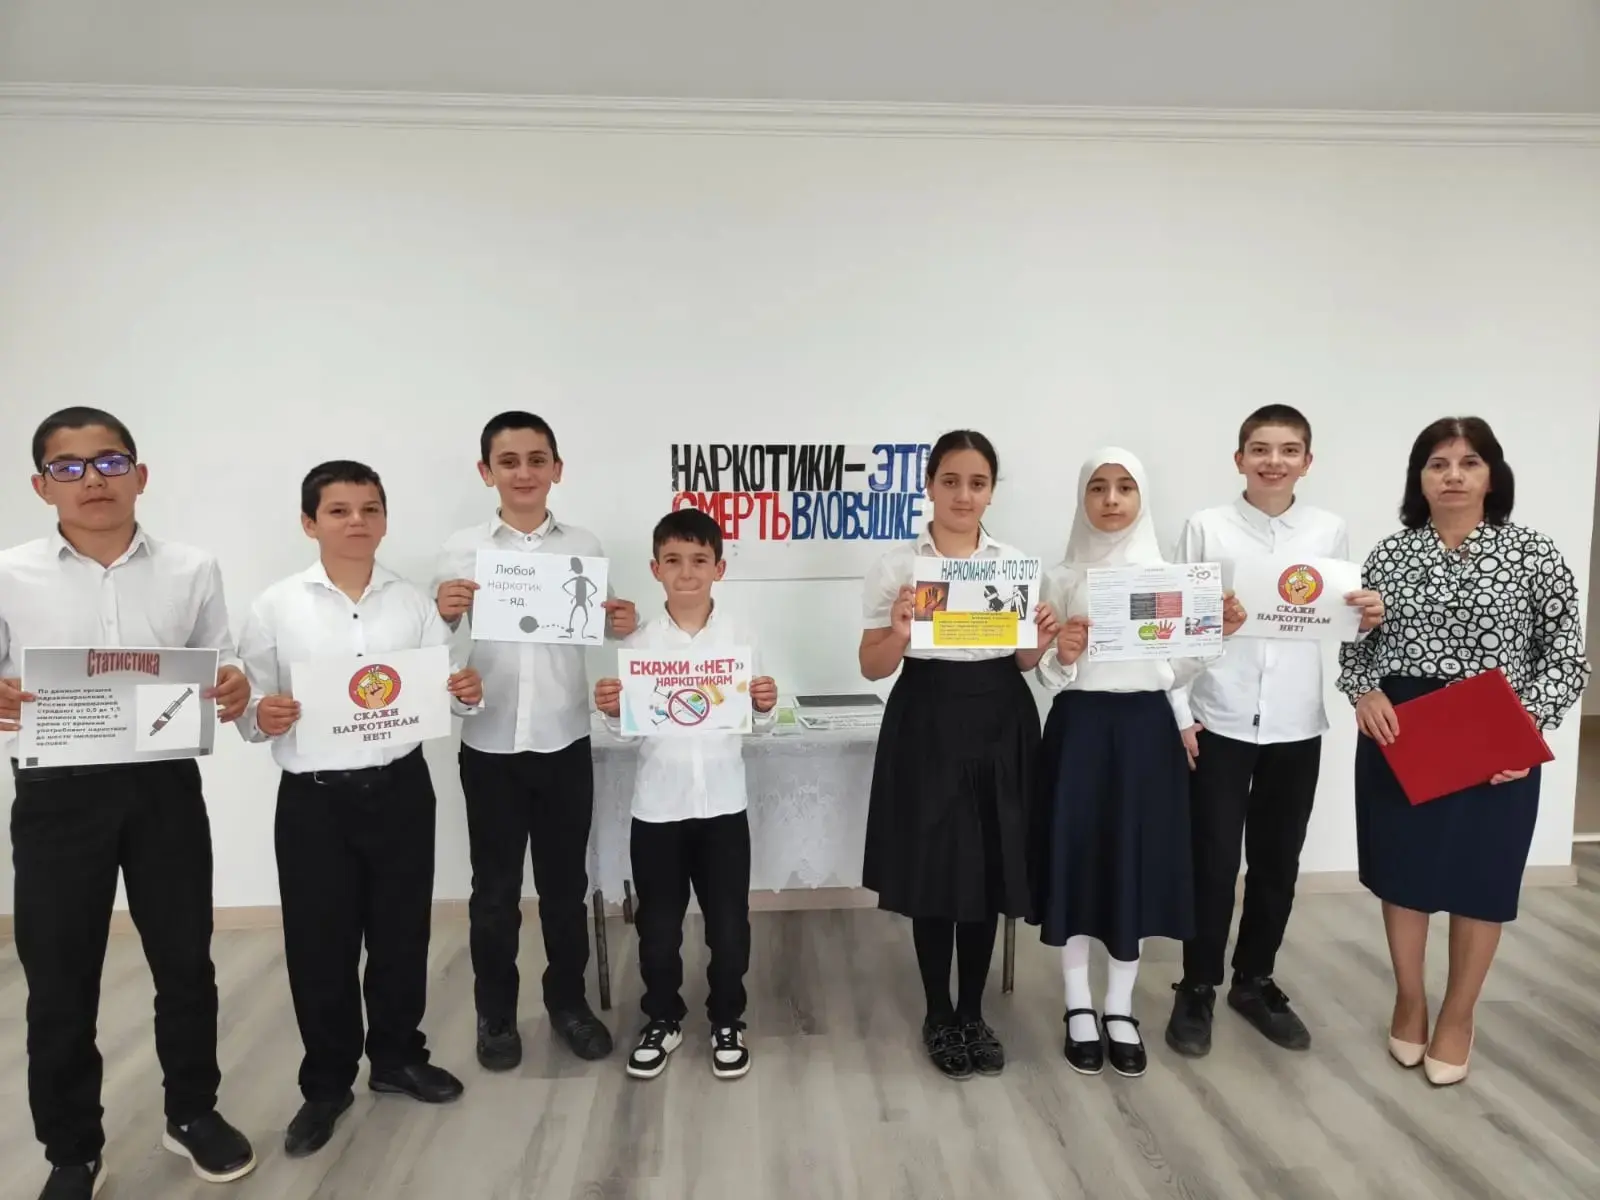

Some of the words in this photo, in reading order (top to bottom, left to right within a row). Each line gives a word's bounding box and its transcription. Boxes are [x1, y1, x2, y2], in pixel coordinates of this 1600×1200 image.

[495, 564, 536, 576] Любой
[941, 560, 997, 581] НАРКОМАНИЯ
[1002, 559, 1018, 580] ЧТО
[1019, 559, 1039, 580] ЭТО?
[487, 579, 542, 592] наркотик
[509, 596, 528, 607] яд.
[1276, 604, 1316, 615] СКАЖИ
[1256, 612, 1332, 624] НАРКОТИКАМ
[1279, 624, 1305, 633] НЕТ!
[87, 648, 161, 677] Статистика
[629, 660, 690, 676] СКАЖИ
[694, 658, 745, 675] «НЕТ»
[655, 675, 733, 688] НАРКОТИКАМ
[353, 707, 400, 722] СКАЖИ
[332, 715, 420, 735] НАРКОТИКАМ
[362, 731, 392, 742] НЕТ!
